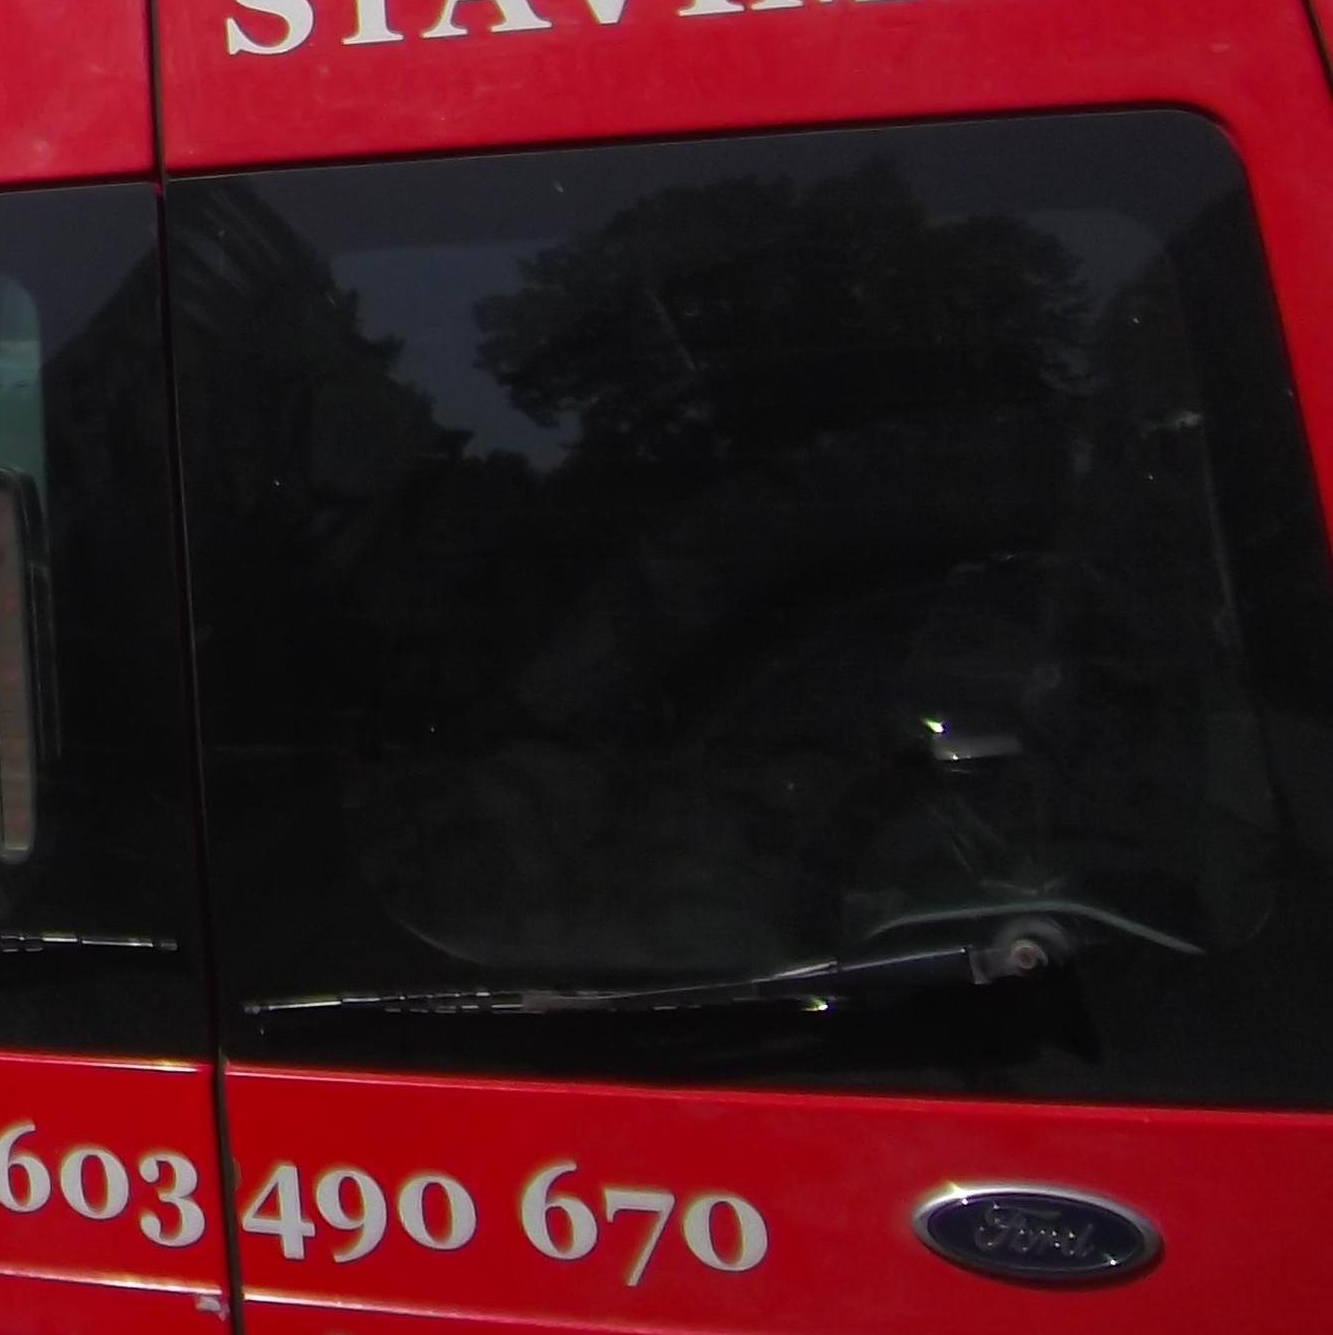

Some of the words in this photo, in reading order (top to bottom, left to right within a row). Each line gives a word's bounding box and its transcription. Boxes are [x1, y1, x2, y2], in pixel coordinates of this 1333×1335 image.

[240, 1161, 479, 1264] 490
[521, 1160, 770, 1288] 670
[971, 1202, 1094, 1259] Ford
